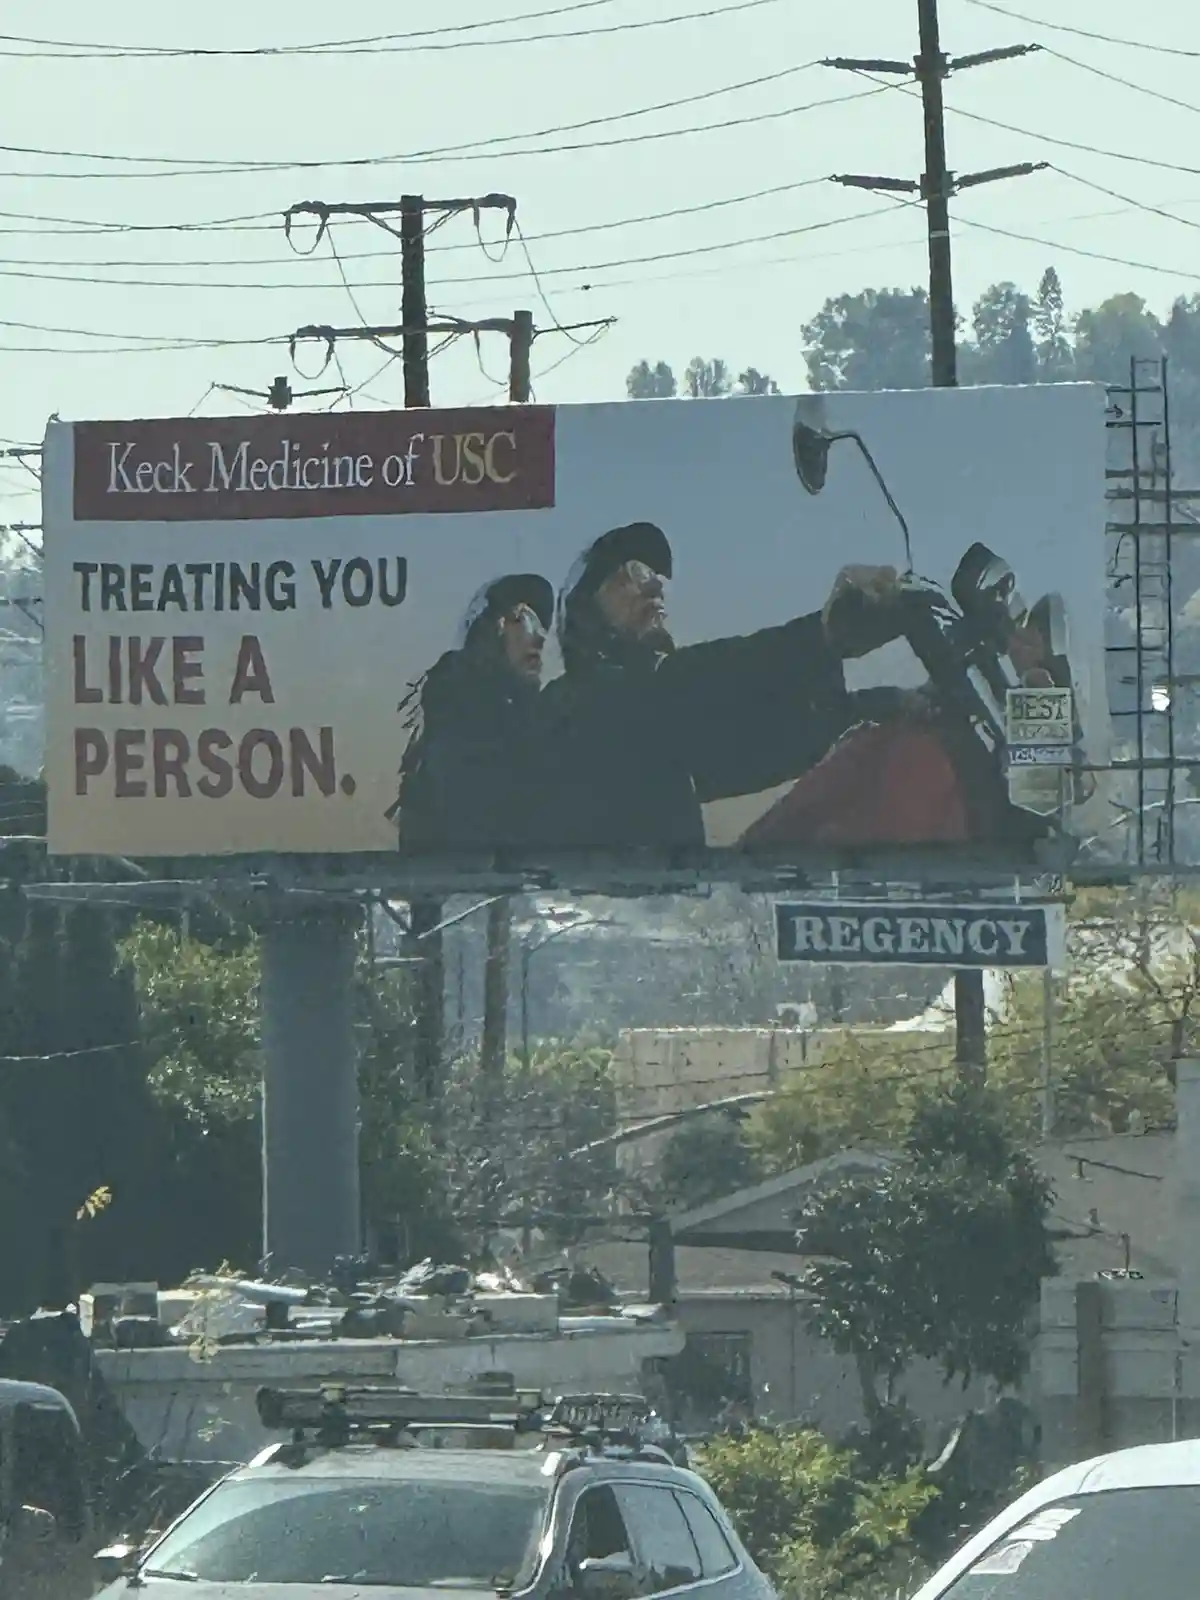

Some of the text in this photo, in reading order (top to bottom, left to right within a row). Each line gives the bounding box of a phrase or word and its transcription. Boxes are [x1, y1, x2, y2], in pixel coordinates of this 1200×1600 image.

[107, 432, 517, 494] Keck Medicine of USC
[73, 556, 408, 612] TREATING YOU
[73, 634, 276, 705] LIKE A
[75, 727, 356, 798] PERSON.
[791, 915, 1031, 955] REGENCY
